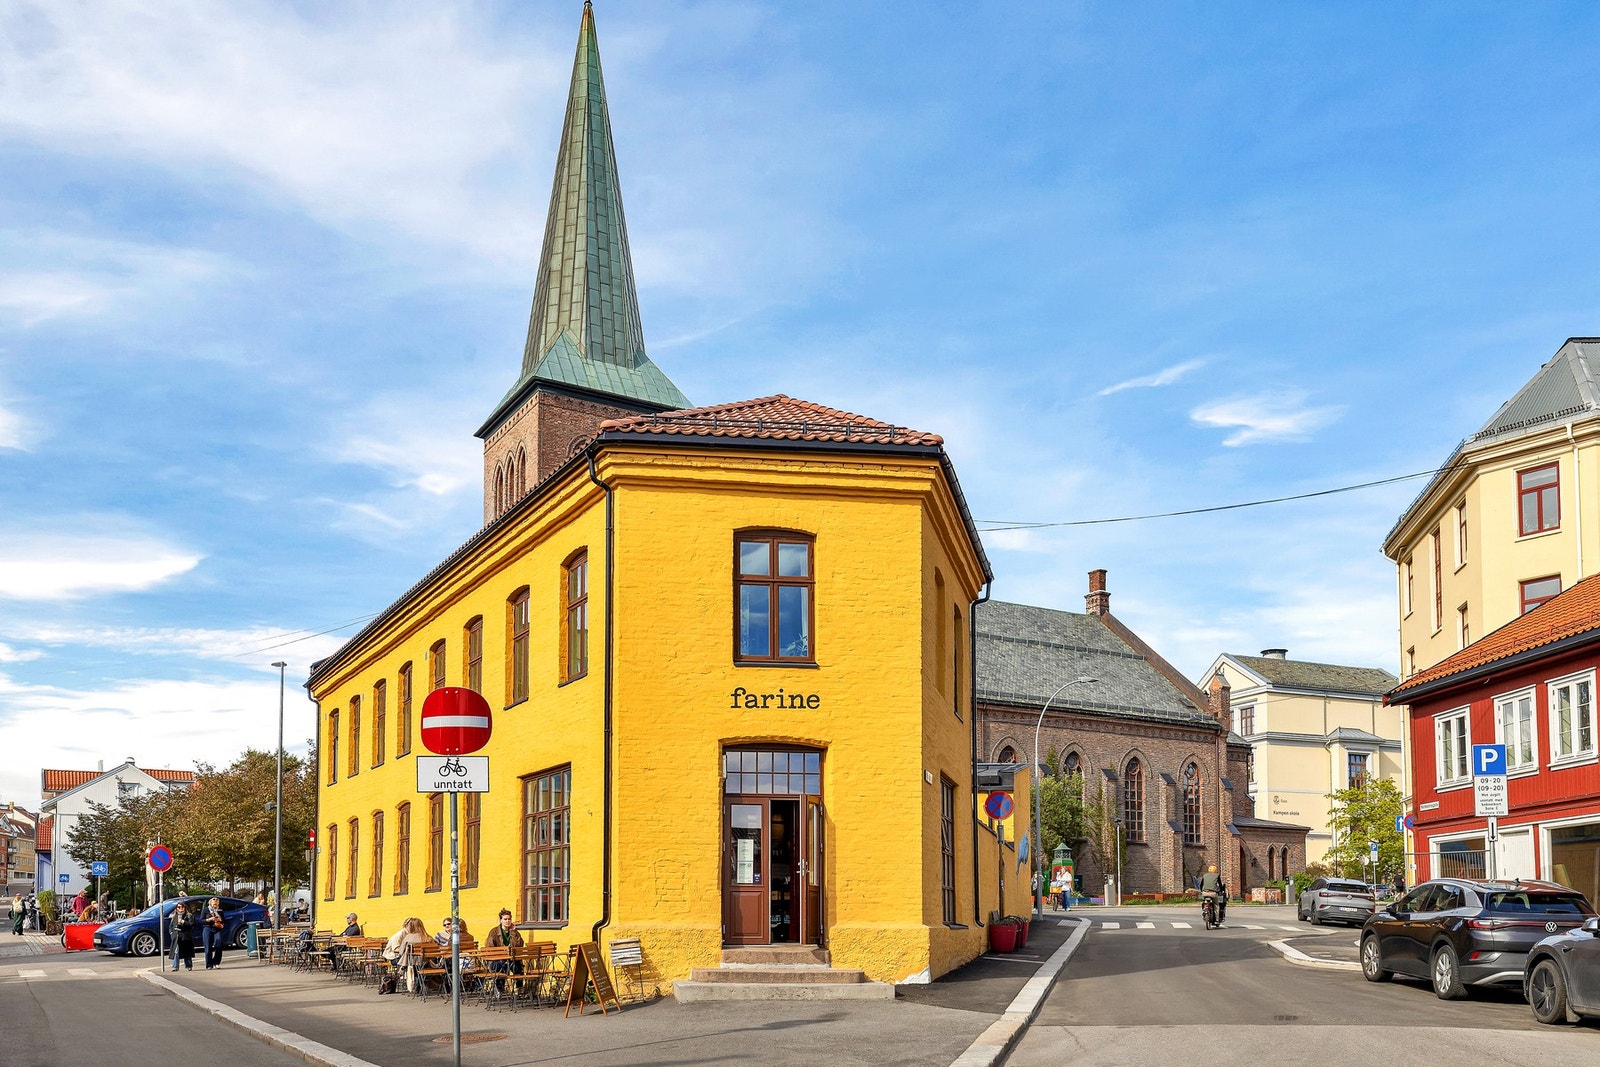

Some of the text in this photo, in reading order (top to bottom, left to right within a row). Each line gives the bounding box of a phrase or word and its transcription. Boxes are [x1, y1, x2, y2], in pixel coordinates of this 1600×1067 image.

[730, 687, 821, 710] farine
[1480, 748, 1499, 772] P
[433, 780, 473, 789] unntatt
